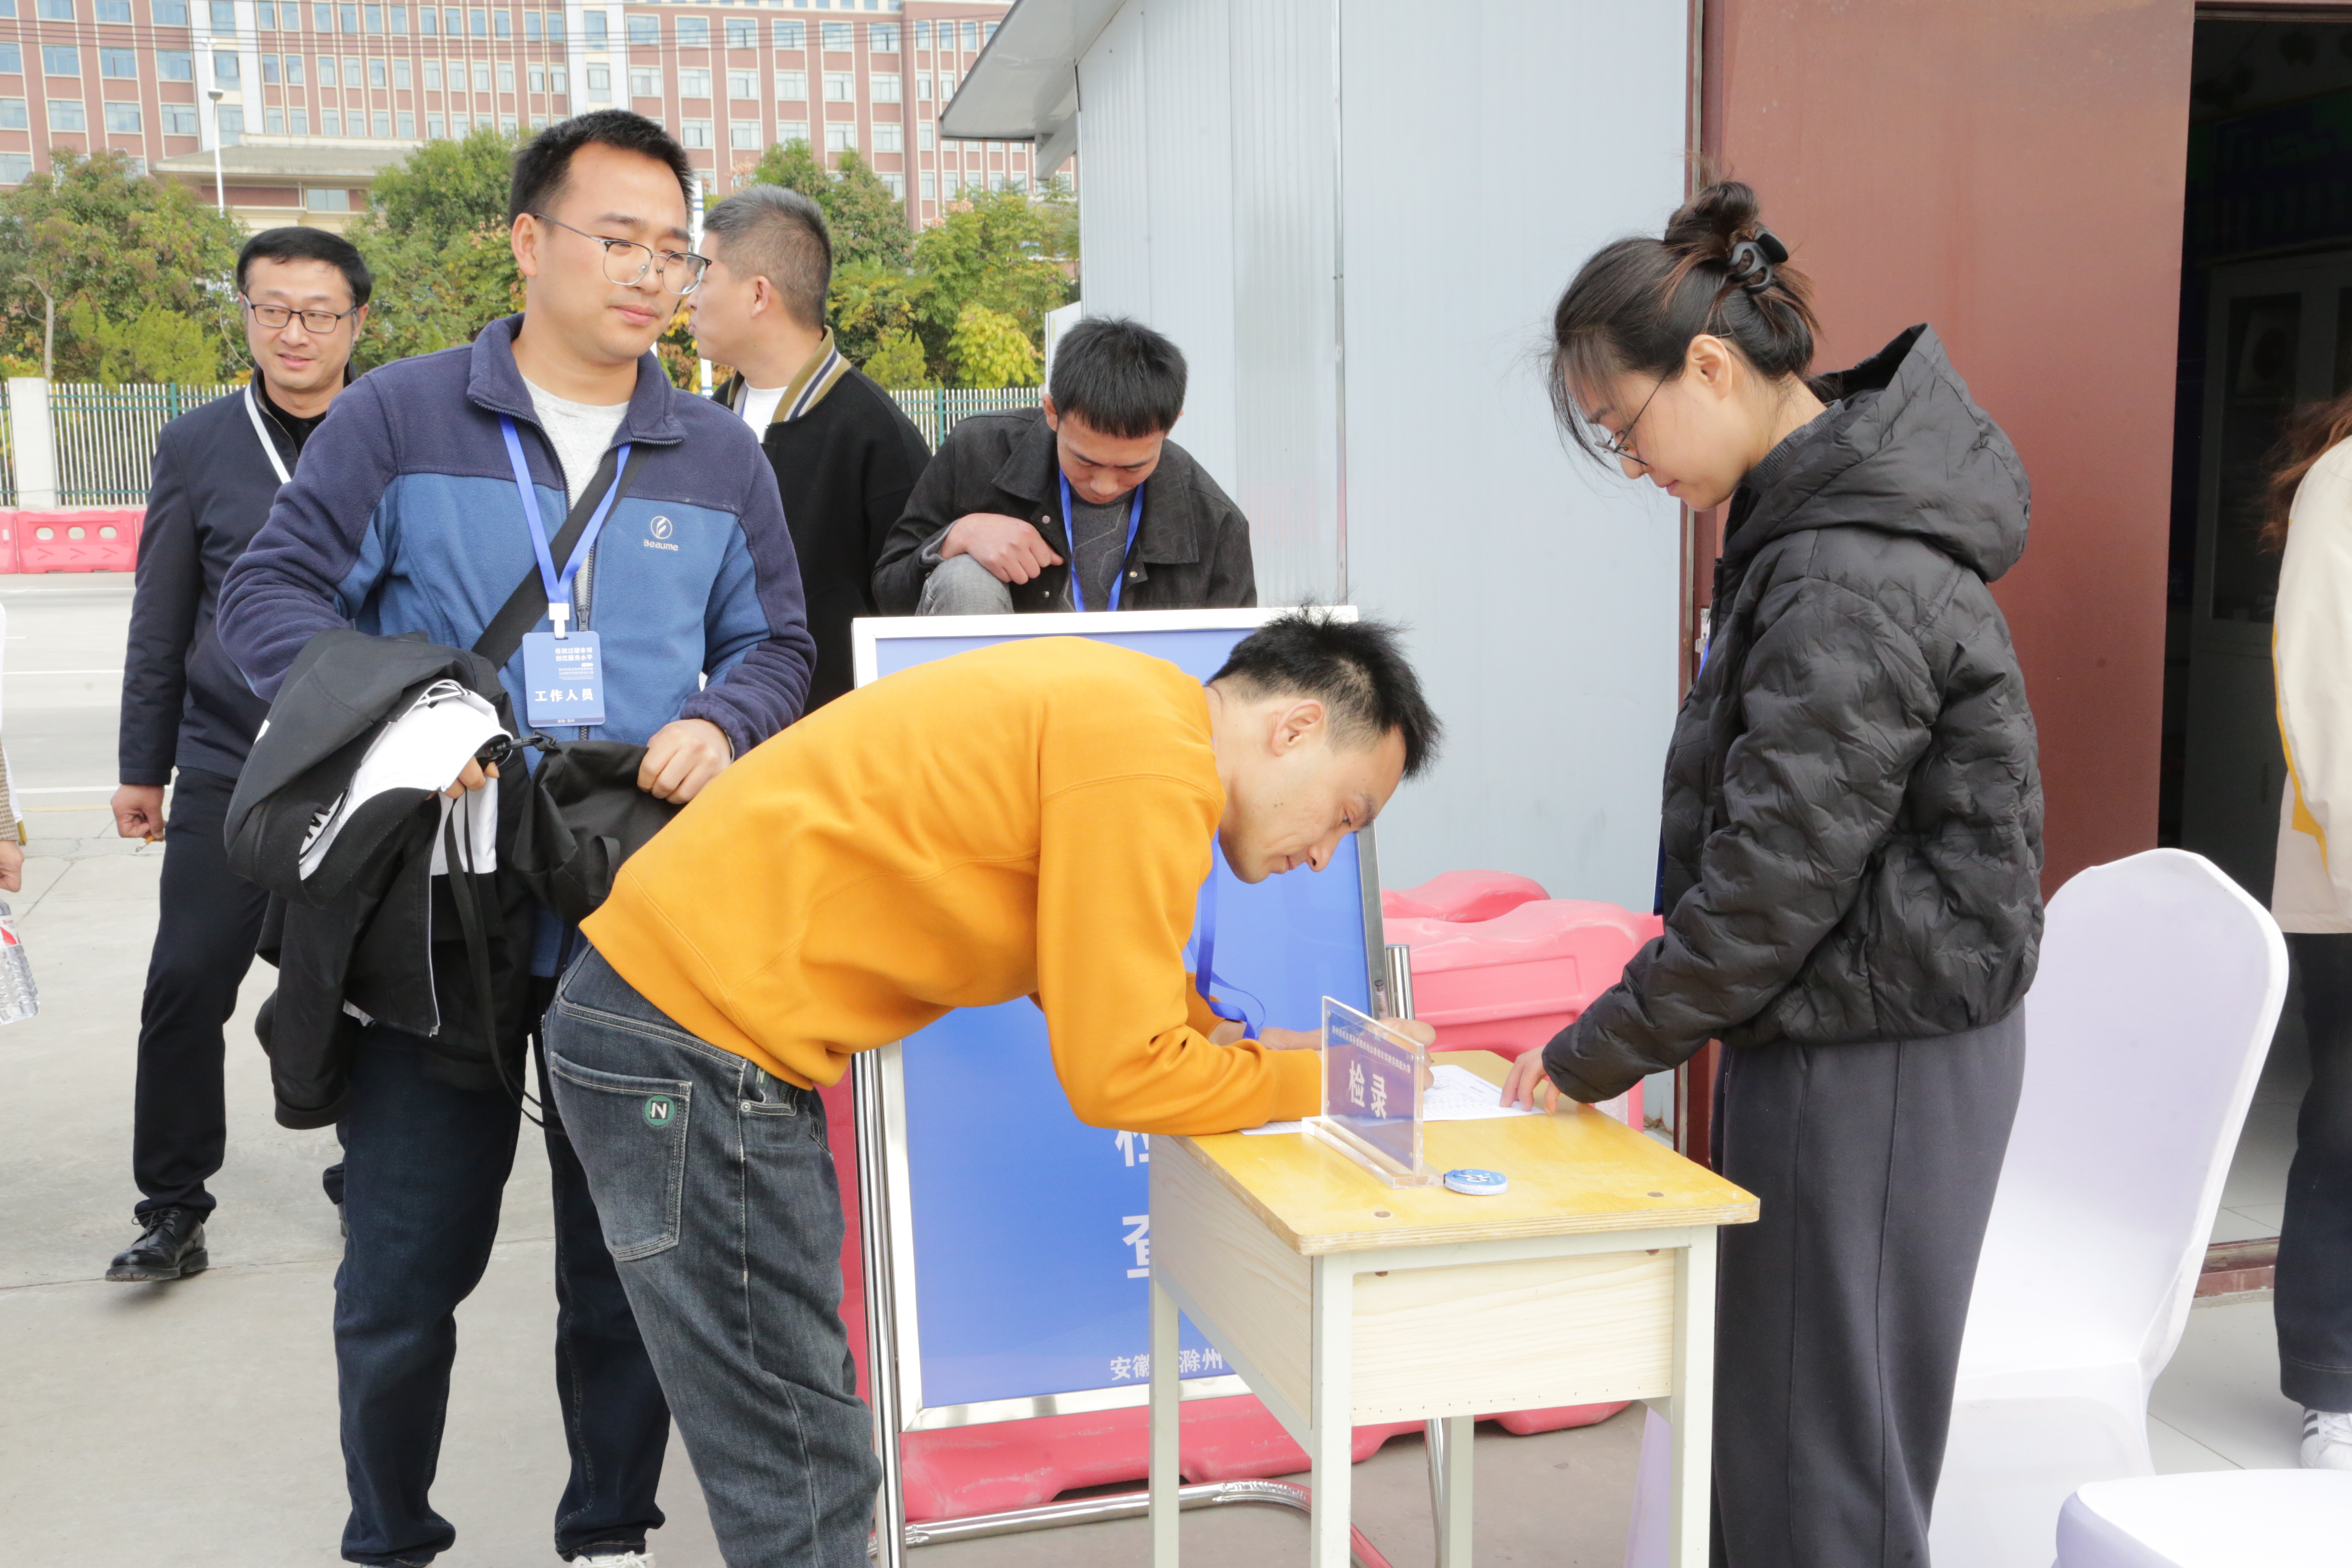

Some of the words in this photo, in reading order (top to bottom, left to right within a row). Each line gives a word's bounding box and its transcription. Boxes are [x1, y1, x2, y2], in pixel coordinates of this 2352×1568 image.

[644, 539, 679, 551] Beaume
[535, 688, 593, 702] 工作人员
[1349, 1060, 1387, 1120] 检录
[651, 1102, 667, 1118] N
